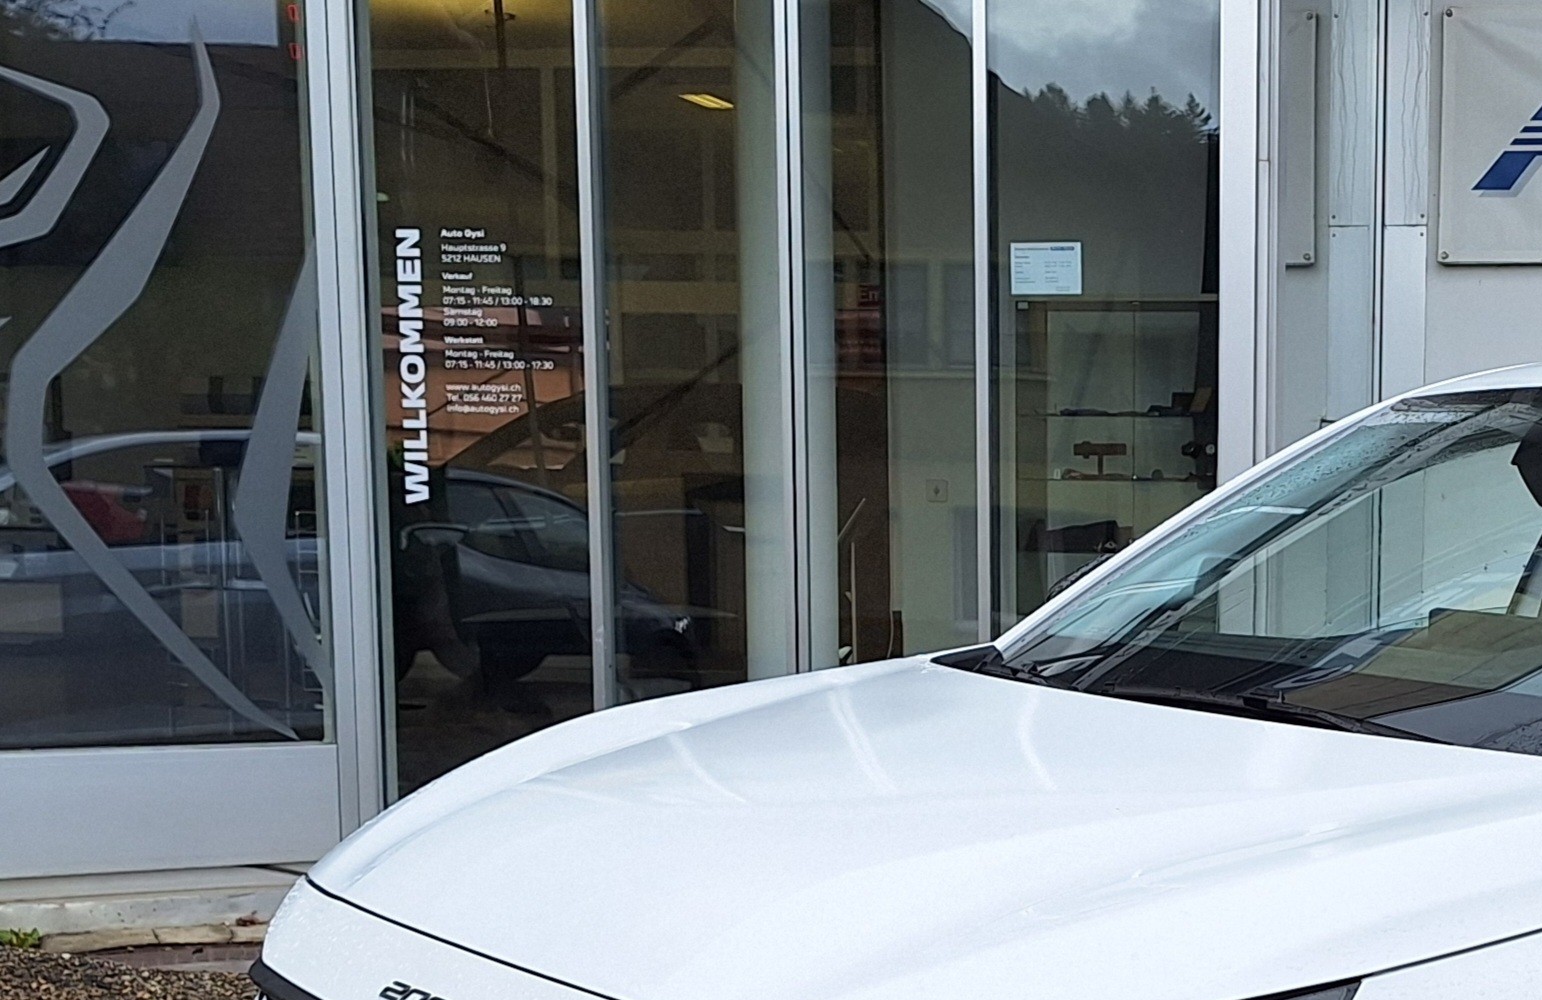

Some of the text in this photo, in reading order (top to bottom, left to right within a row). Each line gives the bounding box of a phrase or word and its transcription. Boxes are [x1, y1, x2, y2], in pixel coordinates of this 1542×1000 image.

[441, 228, 485, 239] Auto Gysi
[441, 243, 507, 253] Hauptstrasse 9
[441, 254, 501, 263] 5212 HAUSEN
[441, 271, 473, 280] Verkauf
[443, 286, 475, 296] Montag
[482, 286, 512, 296] Freitag
[443, 296, 466, 305] 07:15
[472, 296, 494, 305] 11:45
[501, 296, 523, 306] 13:00
[443, 307, 483, 317] Samstag
[443, 336, 483, 344] Werkstatt
[445, 349, 478, 359] Montag
[484, 349, 514, 359] Freitag
[395, 228, 430, 504] WILLKOMMEN
[445, 360, 468, 369] 07:15
[474, 360, 496, 369] 11:45
[502, 360, 525, 370] 13:00
[445, 384, 522, 393] www.autogysi.ch
[446, 404, 520, 414] info@autogysi.ch
